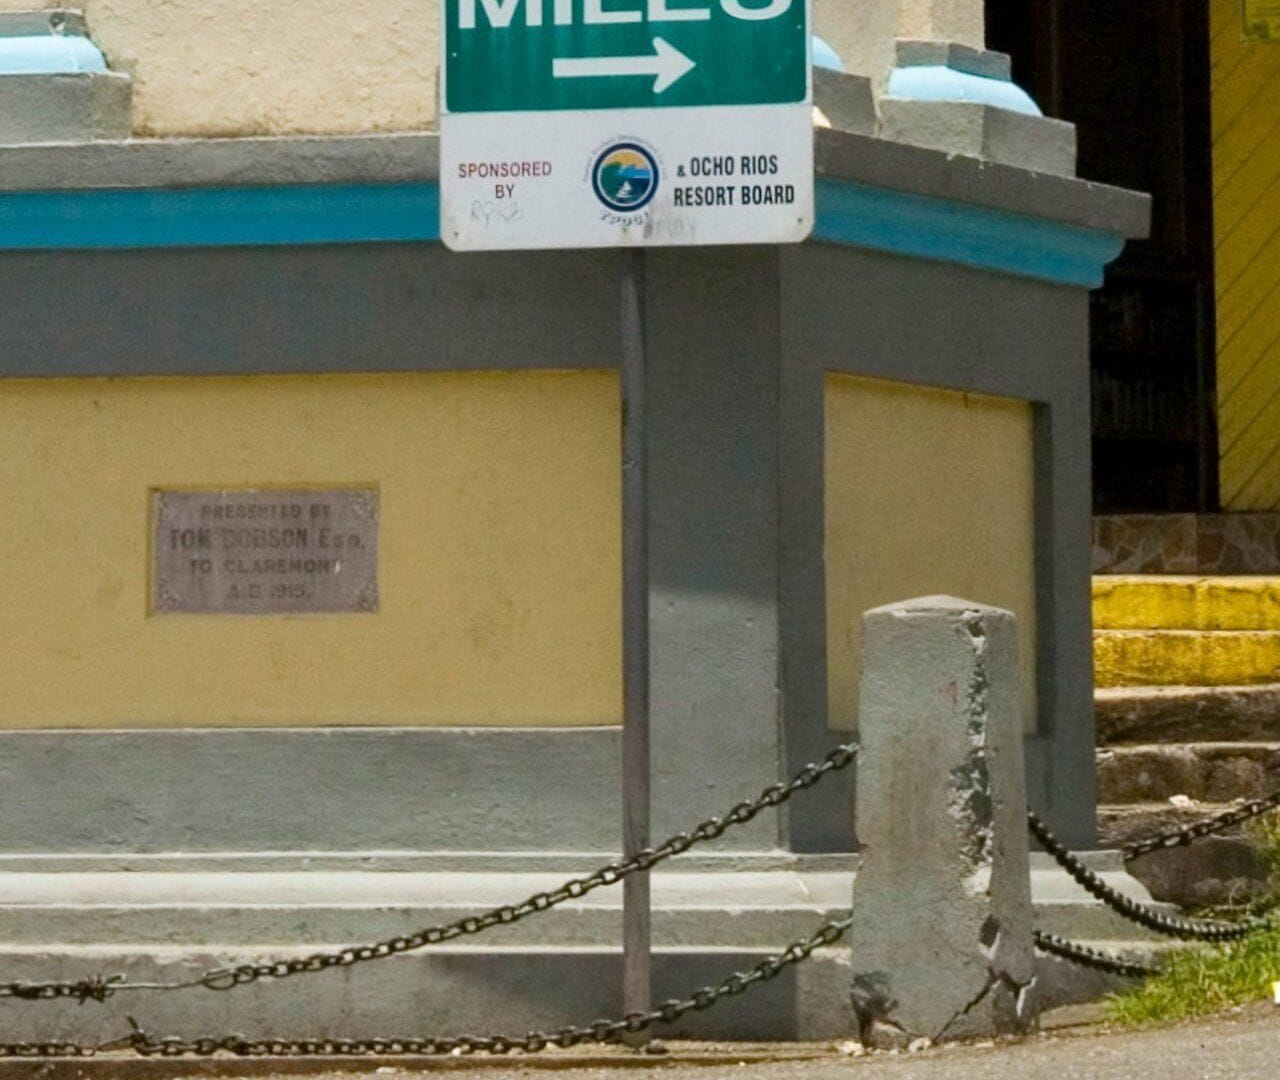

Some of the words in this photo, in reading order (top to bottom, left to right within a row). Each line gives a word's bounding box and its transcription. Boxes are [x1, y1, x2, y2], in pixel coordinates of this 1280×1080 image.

[458, 160, 553, 179] SPONSORED
[676, 164, 686, 178] &
[690, 155, 735, 176] OCHO
[740, 154, 779, 175] RIOS
[495, 183, 515, 199] BY
[674, 185, 736, 207] RESORT
[741, 184, 795, 206] BOARD
[201, 504, 302, 519] PRESENTED
[309, 504, 331, 519] BY
[169, 528, 211, 549] TOM
[222, 528, 308, 549] DOBSON
[189, 559, 212, 574] TO
